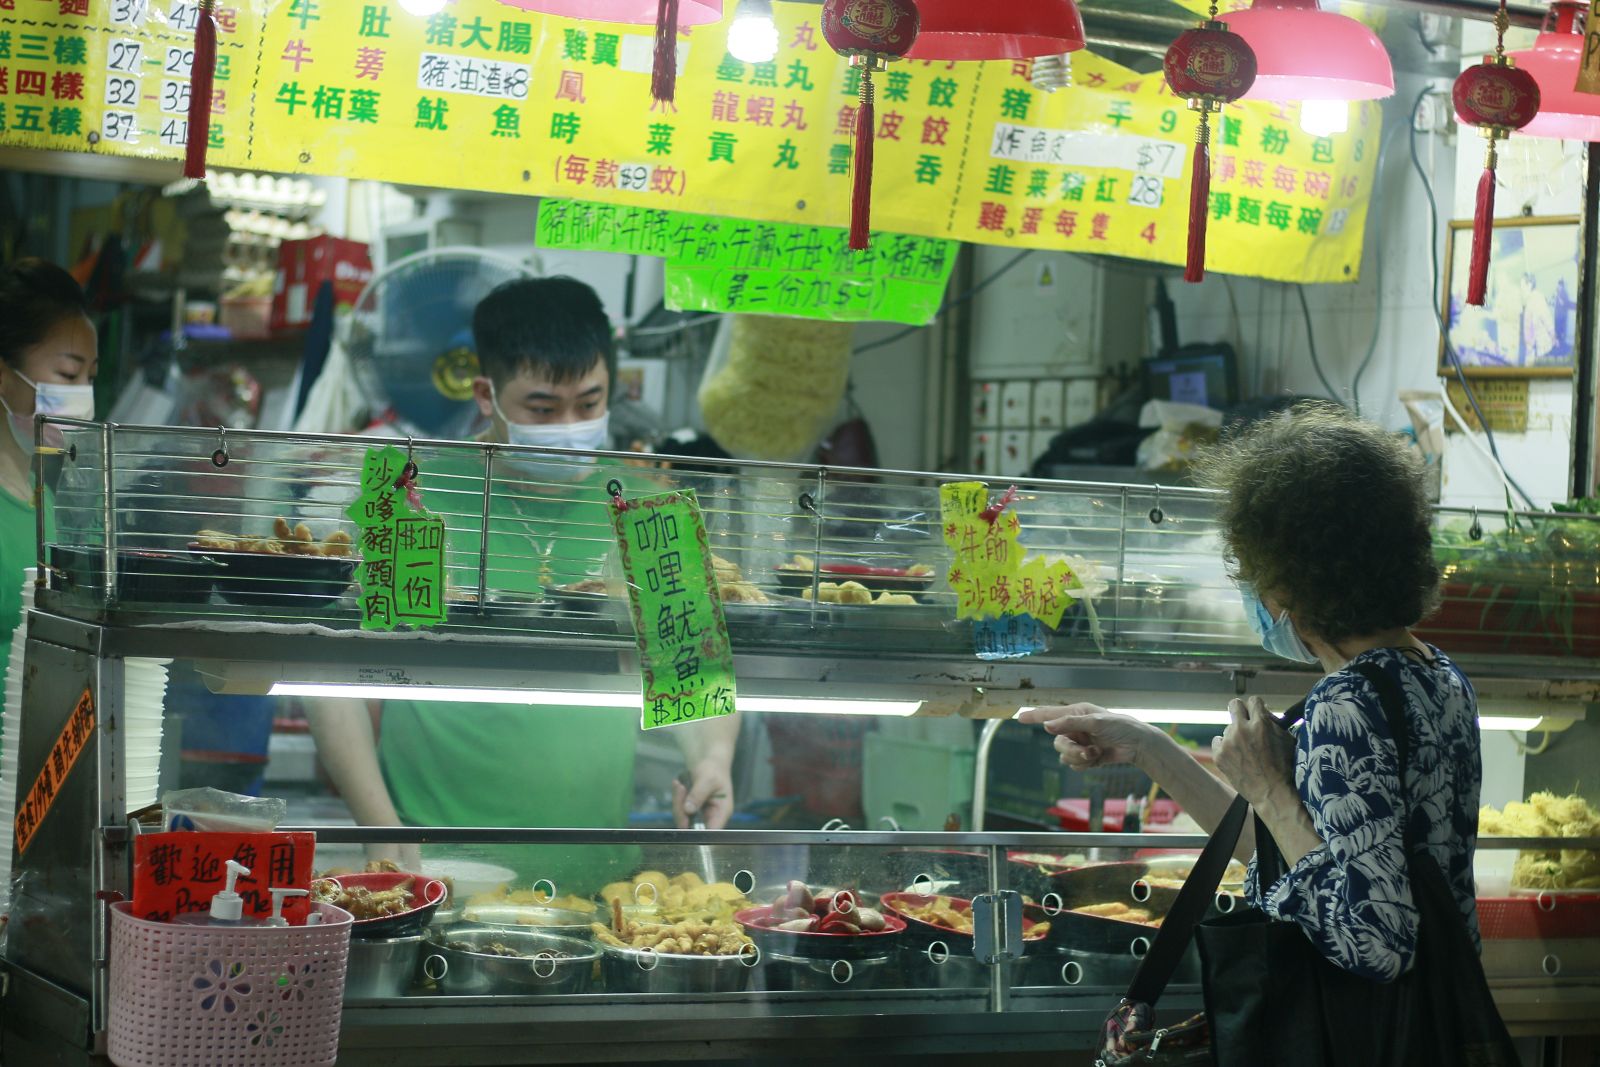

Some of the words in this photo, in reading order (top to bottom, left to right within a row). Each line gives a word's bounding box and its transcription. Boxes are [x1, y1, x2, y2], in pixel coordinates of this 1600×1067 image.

[109, 43, 140, 71] 27
[0, 66, 84, 101] 四樣
[107, 78, 136, 105] 32
[0, 102, 82, 136] 五樣
[105, 113, 133, 140] 37
[414, 96, 521, 138] 魷魚
[550, 111, 675, 156] 時菜
[1160, 109, 1178, 133] 9
[708, 131, 800, 169] 貢丸
[1140, 222, 1158, 245] 4
[399, 524, 440, 551] $10
[402, 561, 434, 609] 一份
[634, 507, 705, 694] 咖哩魷魚
